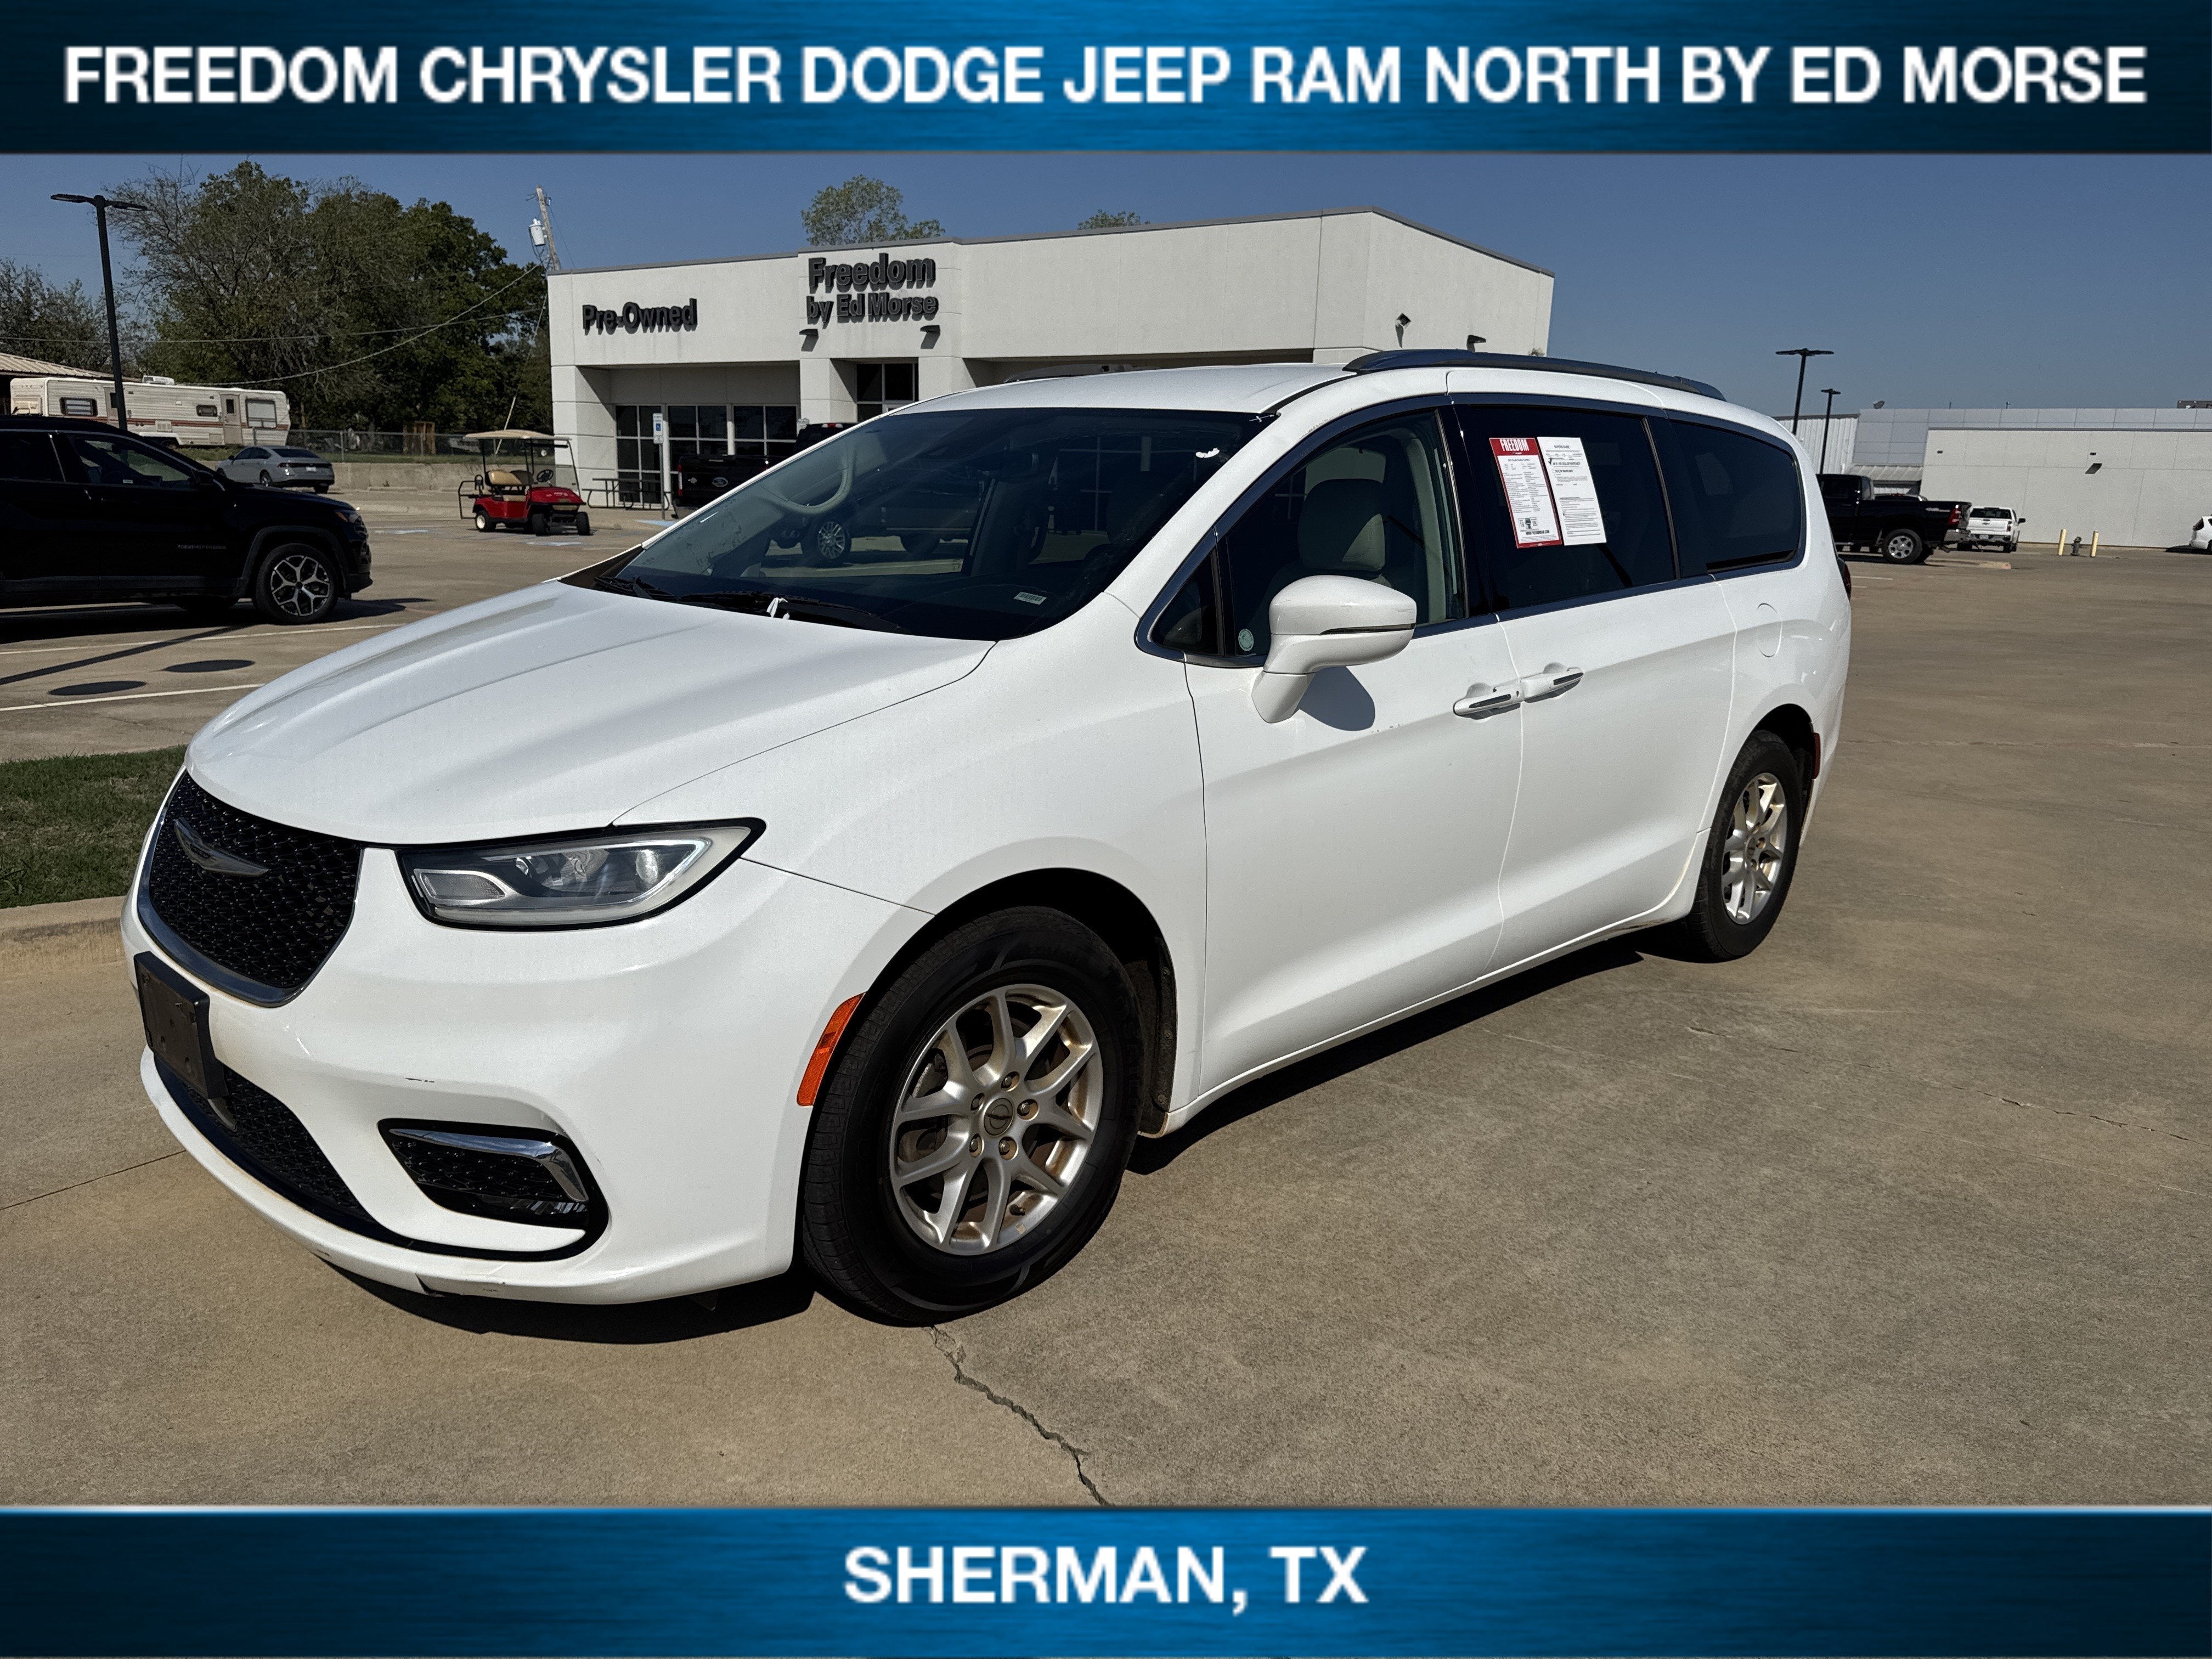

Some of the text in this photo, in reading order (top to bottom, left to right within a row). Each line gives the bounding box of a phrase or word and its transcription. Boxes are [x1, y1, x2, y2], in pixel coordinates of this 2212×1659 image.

[808, 253, 936, 292] Freedom
[582, 298, 697, 331] Pre-Owned
[806, 292, 938, 324] by Ed Morse
[1499, 438, 1530, 451] FREEDOM
